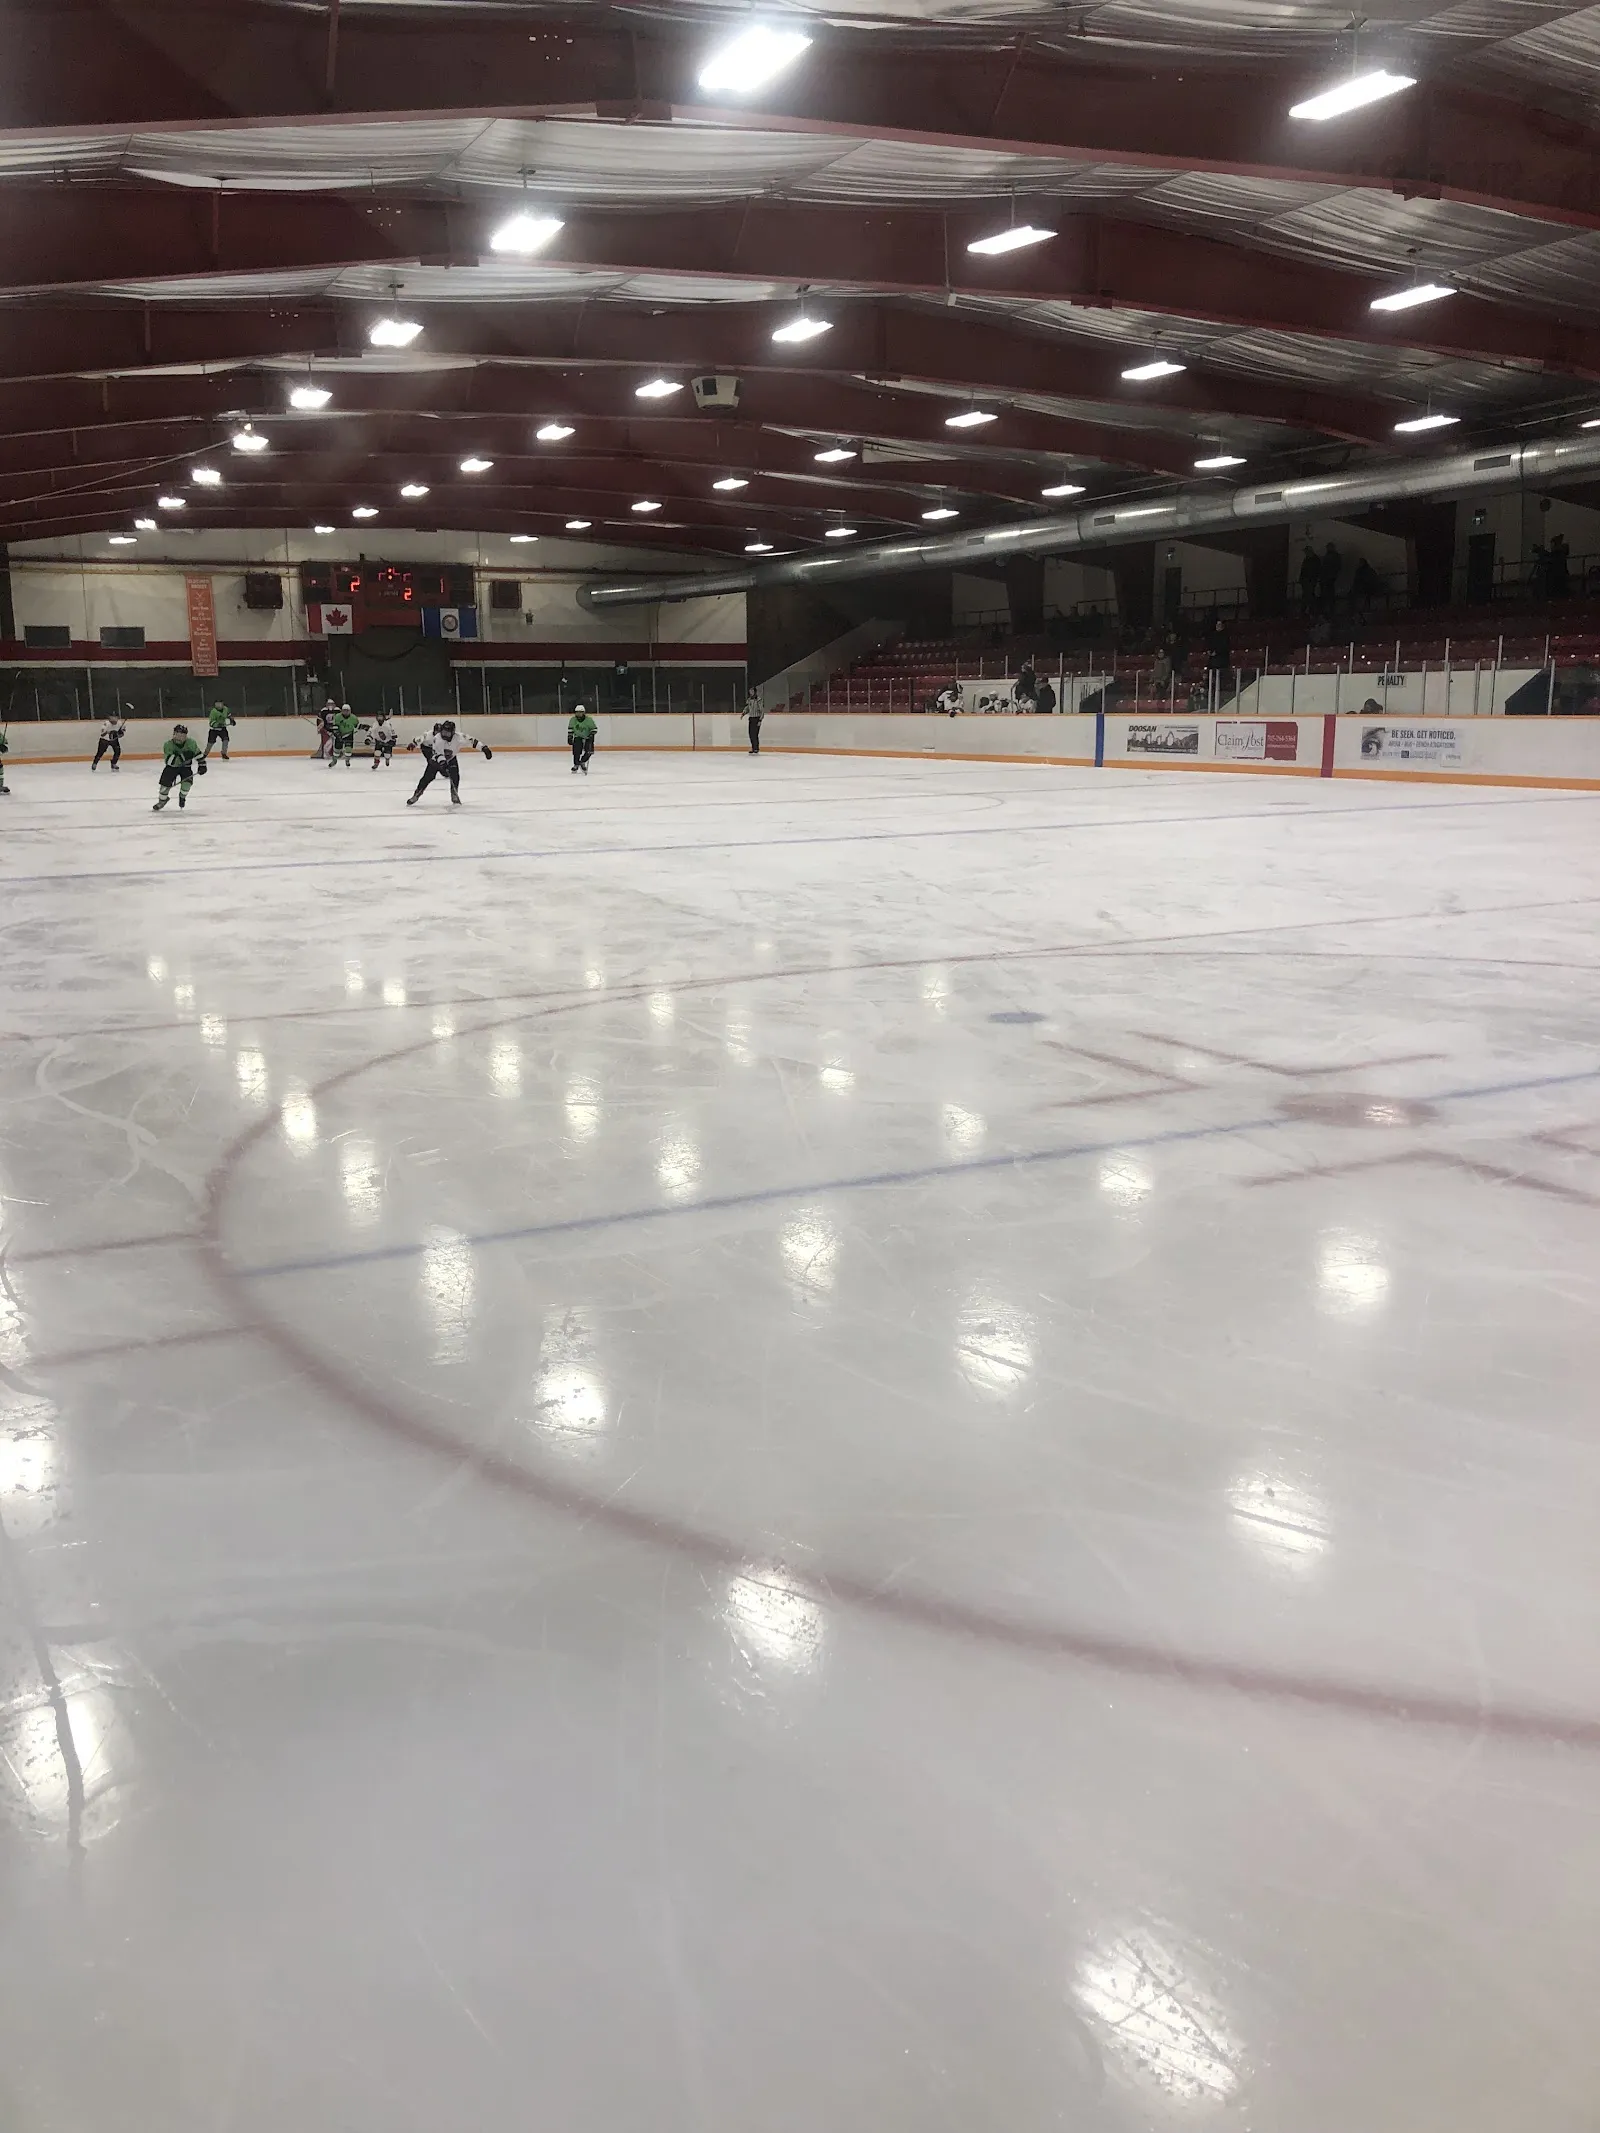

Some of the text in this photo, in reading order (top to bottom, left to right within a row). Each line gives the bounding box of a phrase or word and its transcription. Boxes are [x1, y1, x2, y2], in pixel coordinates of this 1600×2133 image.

[350, 575, 361, 592] 2
[403, 587, 412, 601] 2
[1217, 733, 1243, 746] Claim
[1391, 730, 1399, 739] BE
[1416, 730, 1428, 739] GET
